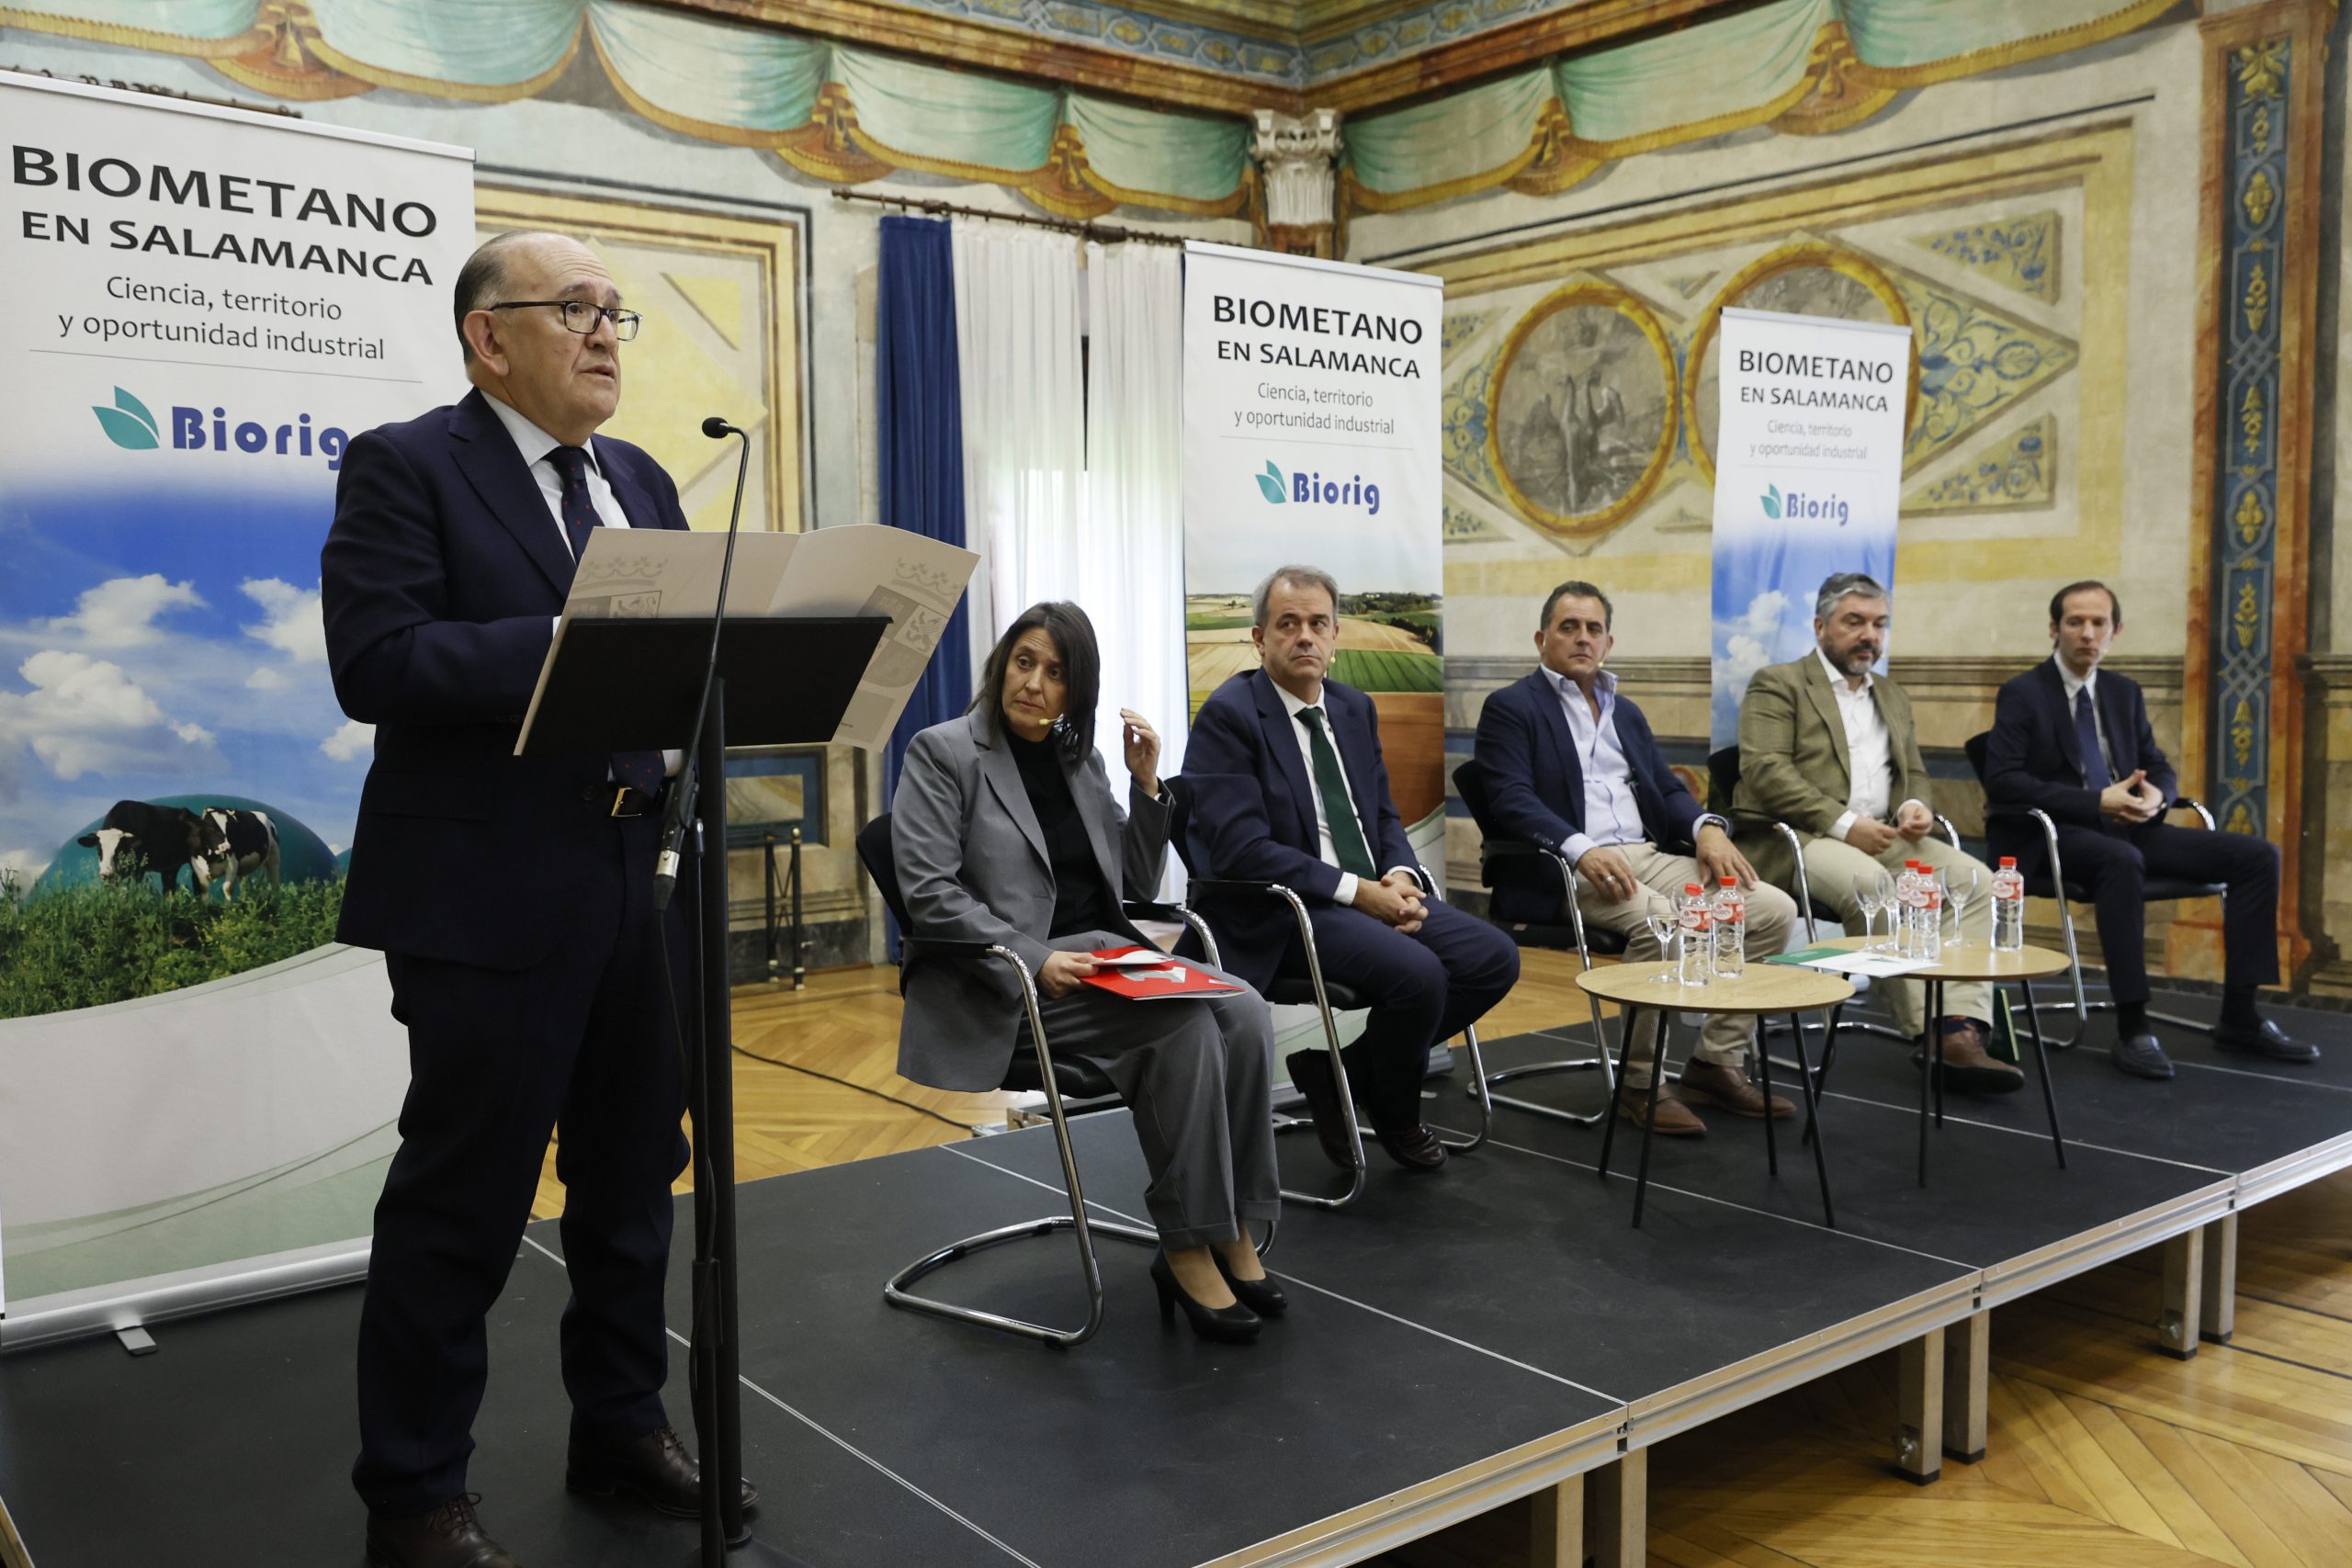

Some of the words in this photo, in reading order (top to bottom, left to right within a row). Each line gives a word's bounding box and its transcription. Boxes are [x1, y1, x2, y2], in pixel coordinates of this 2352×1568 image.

[12, 144, 437, 238] BIOMETANO
[21, 210, 90, 245] EN
[109, 220, 434, 286] SALAMANCA
[107, 276, 213, 310] Ciencia,
[221, 288, 342, 321] territorio
[58, 313, 74, 337] y
[83, 315, 257, 349] oportunidad
[266, 328, 384, 360] industrial
[1214, 295, 1423, 344] BIOMETANO
[1217, 340, 1250, 361] EN
[1260, 343, 1420, 378] SALAMANCA
[1739, 350, 1893, 383] BIOMETANO
[1258, 382, 1309, 404] Ciencia,
[1314, 388, 1374, 407] territorio
[1741, 387, 1764, 402] EN
[1770, 388, 1888, 412] SALAMANCA
[172, 405, 349, 470] Biorig
[1234, 411, 1242, 426] y
[1246, 412, 1331, 429] oportunidad
[1335, 414, 1394, 434] industrial
[1767, 420, 1806, 436] Ciencia,
[1808, 423, 1852, 437] territorio
[1749, 443, 1756, 457] y
[1758, 443, 1820, 457] oportunidad
[1822, 445, 1868, 459] industrial
[1293, 471, 1380, 515] Biorig
[1786, 492, 1849, 526] Biorig
